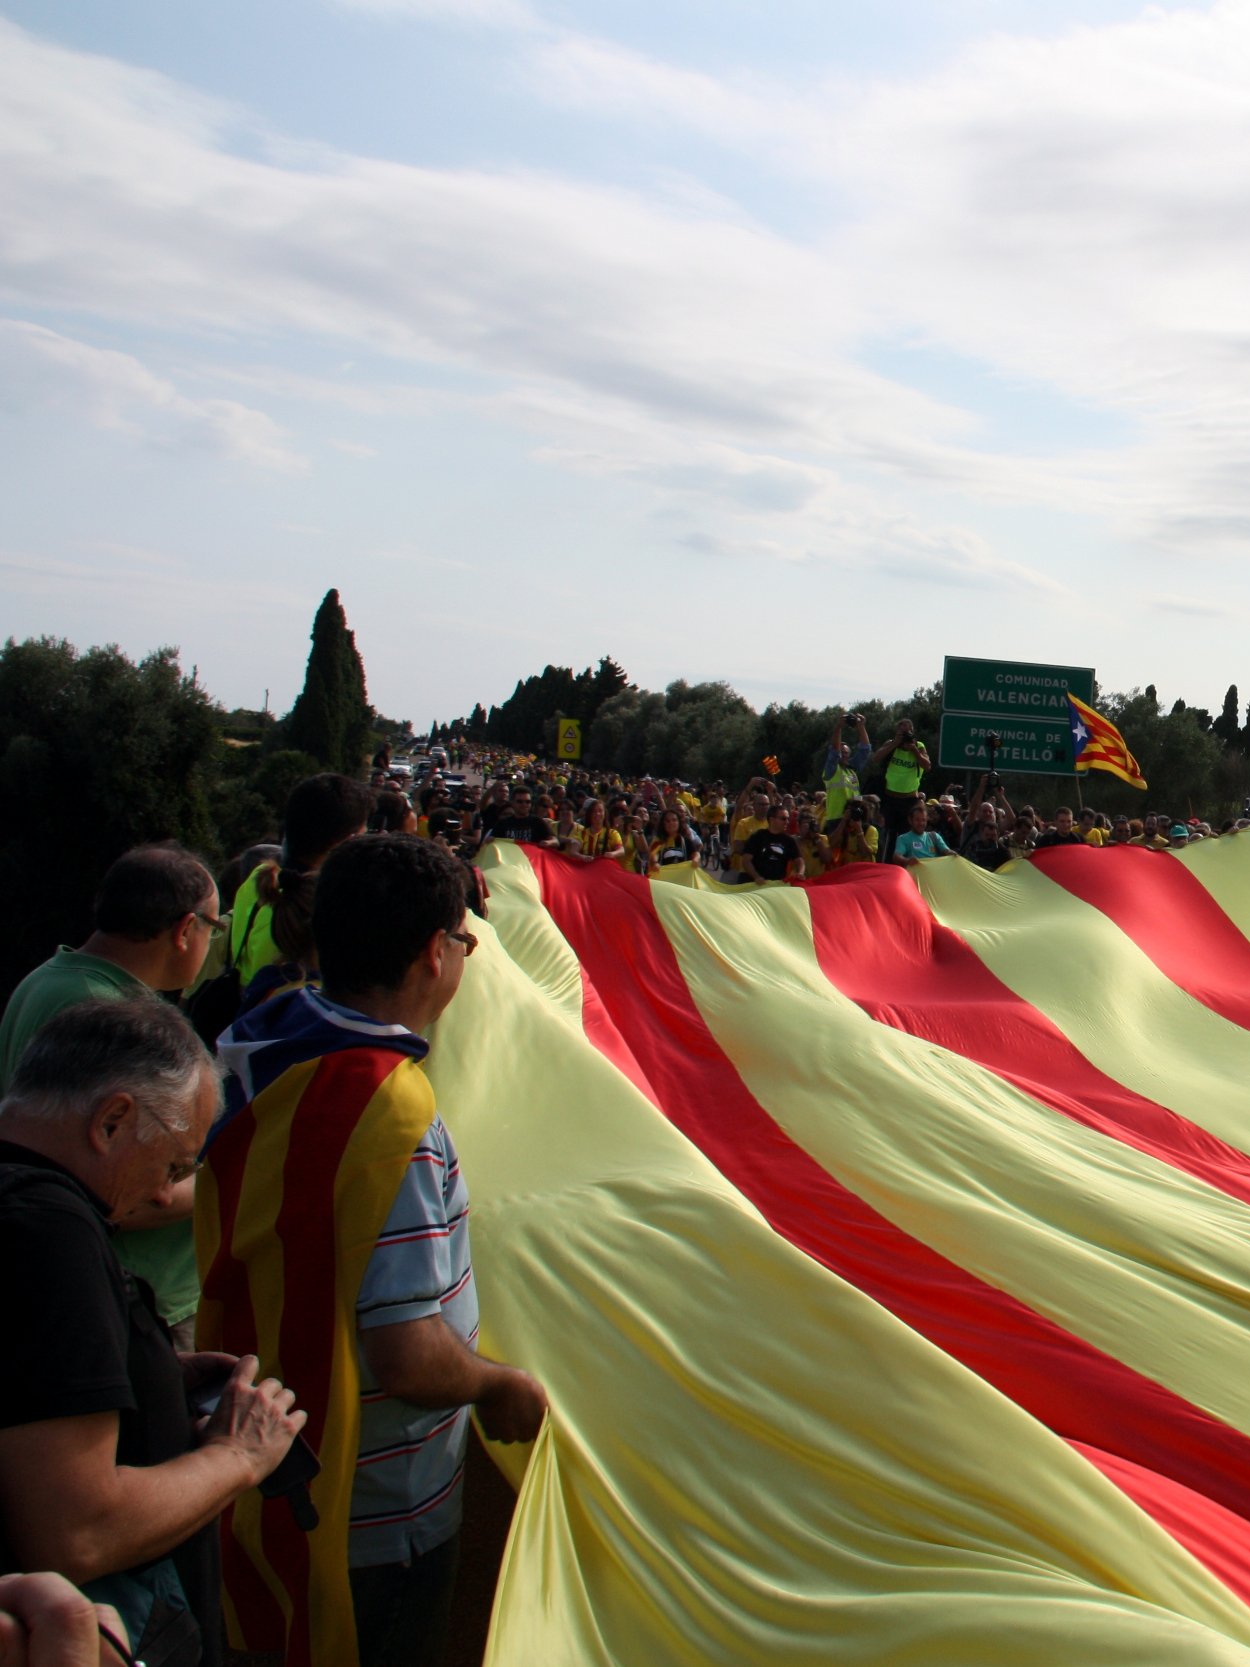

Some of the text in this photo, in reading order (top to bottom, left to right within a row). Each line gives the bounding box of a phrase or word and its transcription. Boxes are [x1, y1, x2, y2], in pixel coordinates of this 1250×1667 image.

[995, 674, 1068, 688] COMUNIDAD
[977, 689, 1069, 708] VALENCIAN
[1046, 733, 1062, 743] DE
